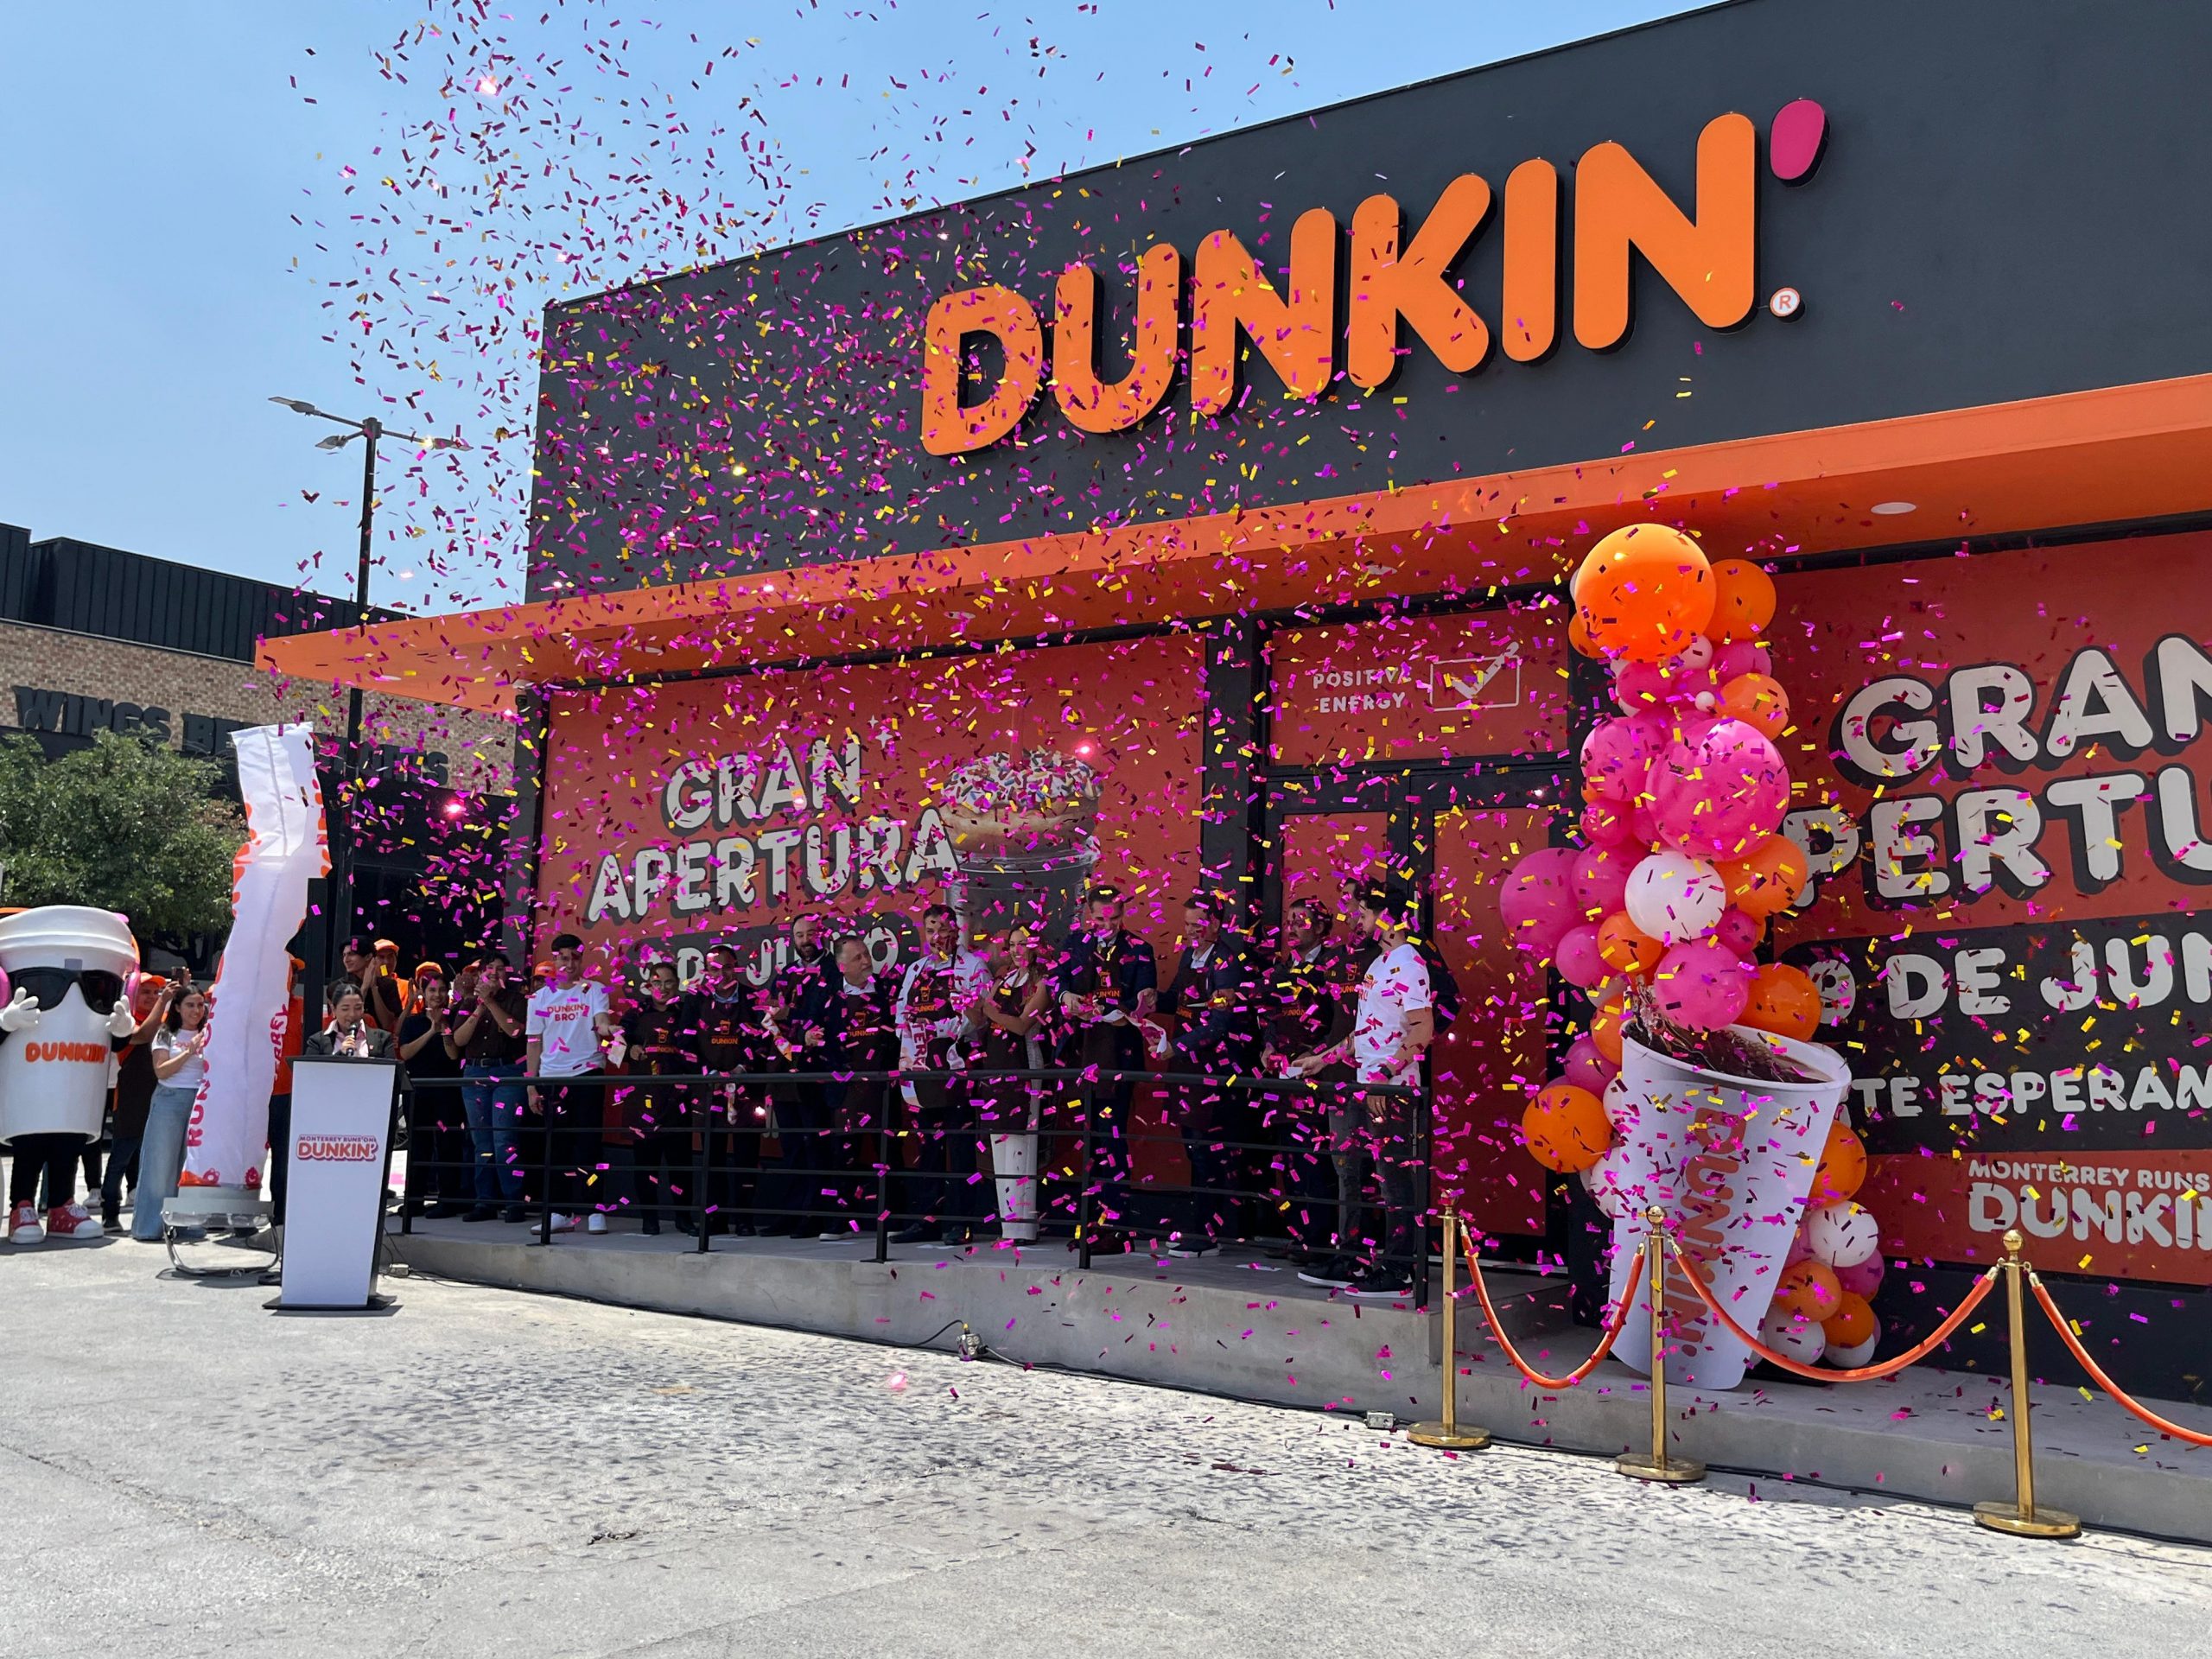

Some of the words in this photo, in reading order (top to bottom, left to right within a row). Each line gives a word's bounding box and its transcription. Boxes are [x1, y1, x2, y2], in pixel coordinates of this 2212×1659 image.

[921, 98, 1826, 456] DUNKIN'
[11, 685, 171, 743] WINGS
[1319, 691, 1405, 714] ENERGY
[665, 734, 861, 830] GRAN
[588, 809, 957, 923] APERTURA
[1885, 948, 2011, 1020] DE
[298, 1141, 377, 1159] DUNKIN'
[1968, 1160, 2129, 1187] MONTERREY
[2137, 1169, 2210, 1192] RUNS
[1968, 1182, 2212, 1251] DUNKI
